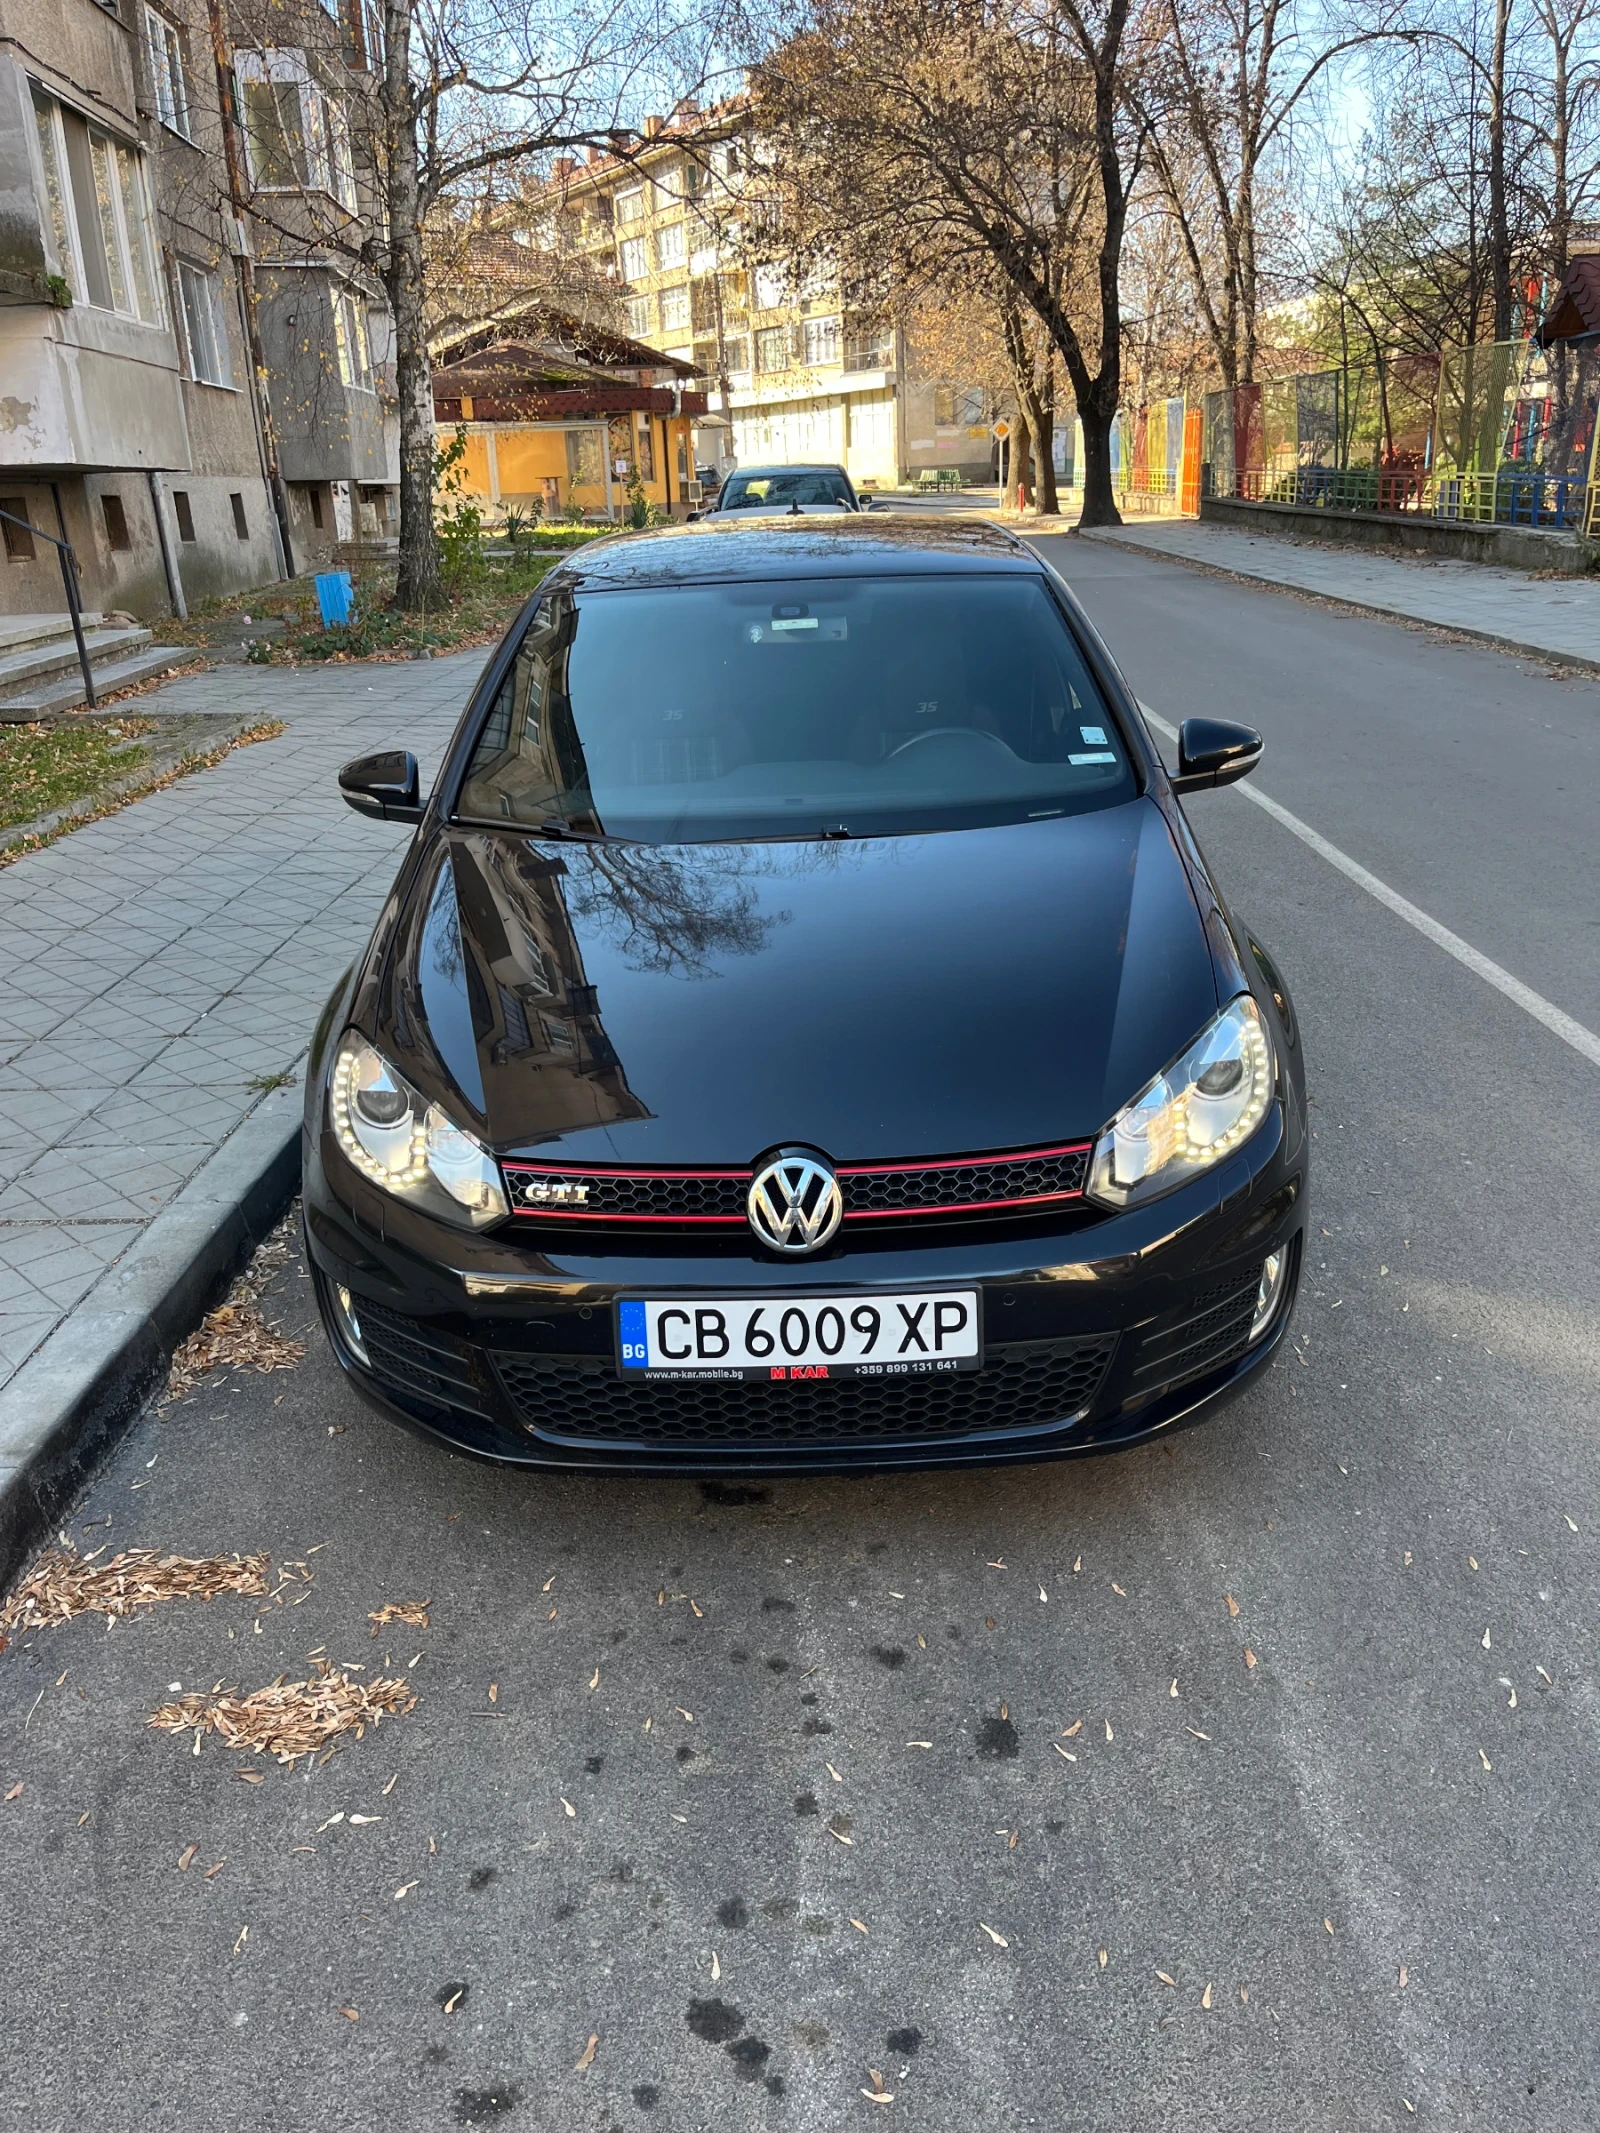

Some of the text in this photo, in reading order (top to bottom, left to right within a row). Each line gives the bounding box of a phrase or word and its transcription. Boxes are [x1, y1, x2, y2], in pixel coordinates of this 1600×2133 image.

[916, 701, 939, 713] 35
[662, 709, 685, 721] 35
[525, 1183, 590, 1204] GTI
[748, 1157, 843, 1254] VW
[657, 1301, 968, 1360] CB 6009 XP
[622, 1343, 646, 1359] BG
[644, 1369, 744, 1380] www.m-kar.mobile.bg
[770, 1365, 829, 1380] M KAR
[854, 1360, 958, 1375] +359 899 131 641
